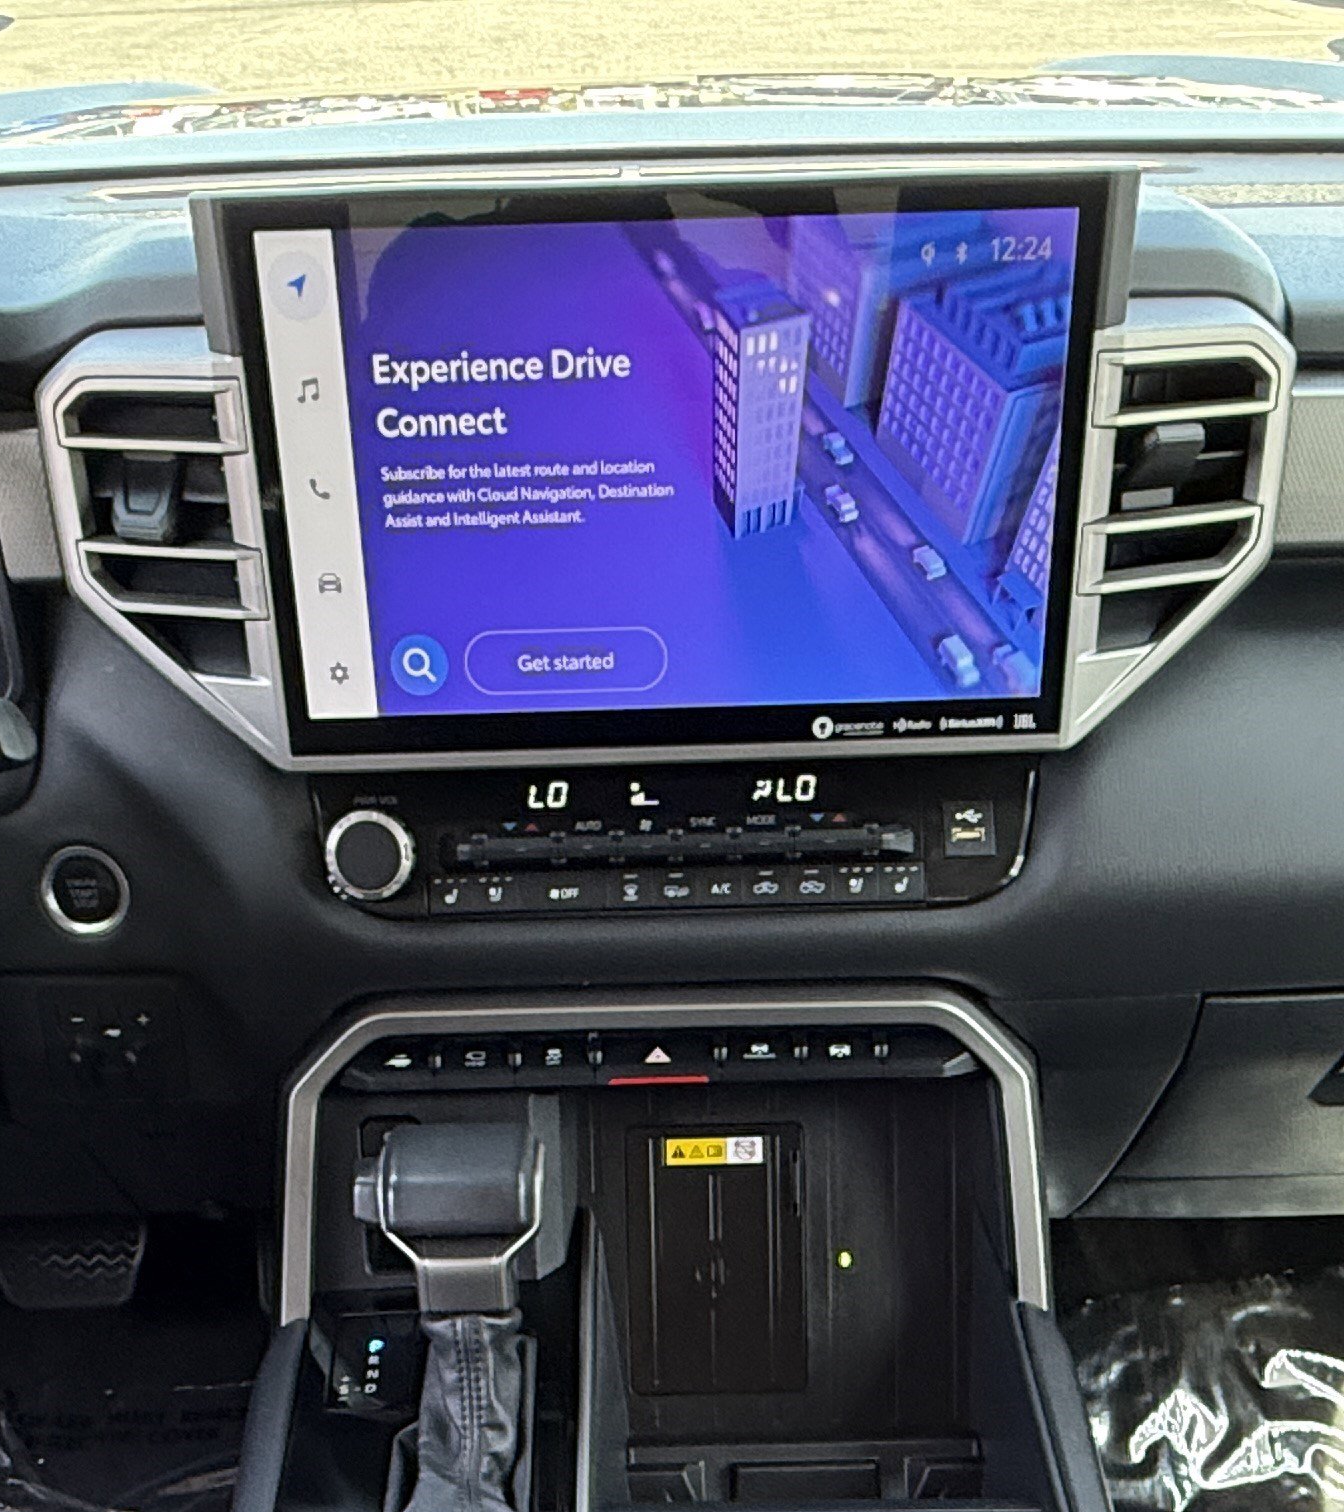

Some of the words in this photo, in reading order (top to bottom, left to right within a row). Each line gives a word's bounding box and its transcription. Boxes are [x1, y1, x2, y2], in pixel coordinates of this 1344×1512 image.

[990, 236, 1052, 262] 12:24
[372, 350, 544, 392] Experience
[551, 347, 631, 380] Drive
[376, 407, 508, 438] Connect
[380, 465, 446, 482] Subscribe
[448, 464, 467, 480] for
[468, 464, 491, 479] the
[493, 463, 532, 478] latest
[534, 464, 570, 477] route
[572, 461, 598, 476] and
[600, 459, 655, 475] location
[382, 489, 445, 508] guidance
[446, 487, 475, 502] with
[477, 486, 518, 502] Cloud
[520, 486, 596, 503] Navigation,
[598, 483, 675, 499] Destination
[384, 513, 423, 528] Assist
[425, 512, 451, 527] and
[453, 511, 520, 530] Intelligent
[517, 654, 551, 672] Get
[553, 651, 616, 671] started
[527, 780, 570, 808] LO
[777, 774, 818, 802] LO
[575, 820, 602, 831] AUTO
[560, 886, 580, 898] OFF
[710, 882, 732, 895] A/C
